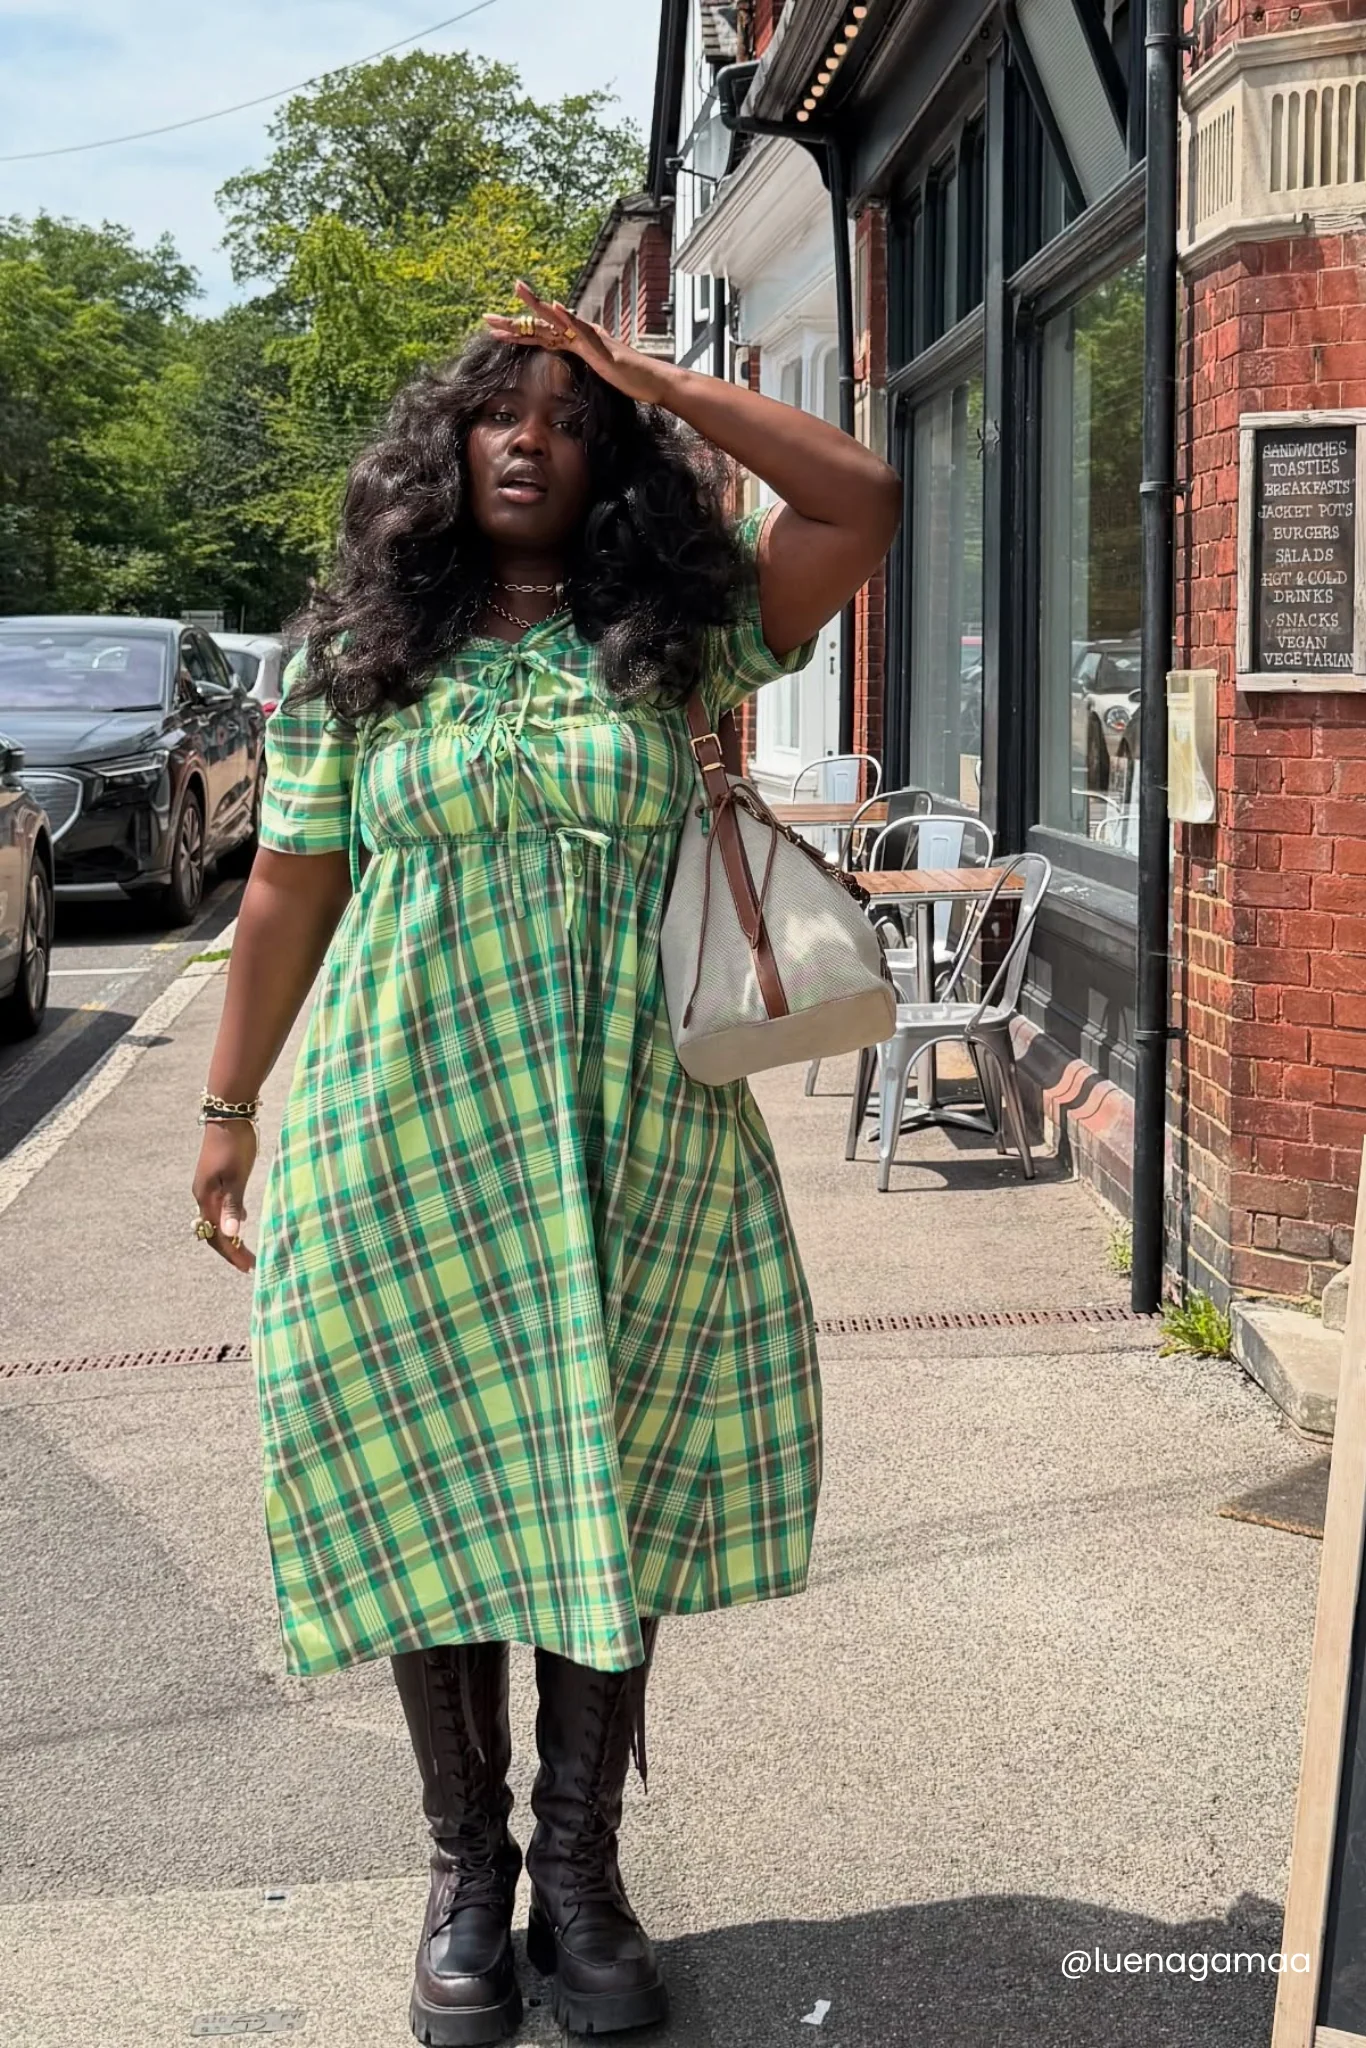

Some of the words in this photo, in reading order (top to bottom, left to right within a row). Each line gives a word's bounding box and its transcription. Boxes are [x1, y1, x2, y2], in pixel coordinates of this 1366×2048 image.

[1263, 441, 1347, 459] SANDWICHES
[1269, 459, 1340, 476] TOASTIES
[1264, 480, 1350, 496] BREAKFASTS
[1258, 504, 1313, 519] JACKET
[1318, 502, 1353, 517] POTS
[1272, 526, 1340, 540] BURGERS
[1275, 548, 1334, 563] SALADS
[1307, 570, 1347, 586] COLD
[1273, 588, 1333, 603] DRINKS
[1276, 612, 1339, 628] SNACKS
[1276, 635, 1327, 649] VEGAN
[1263, 652, 1354, 668] VEGETARIAN
